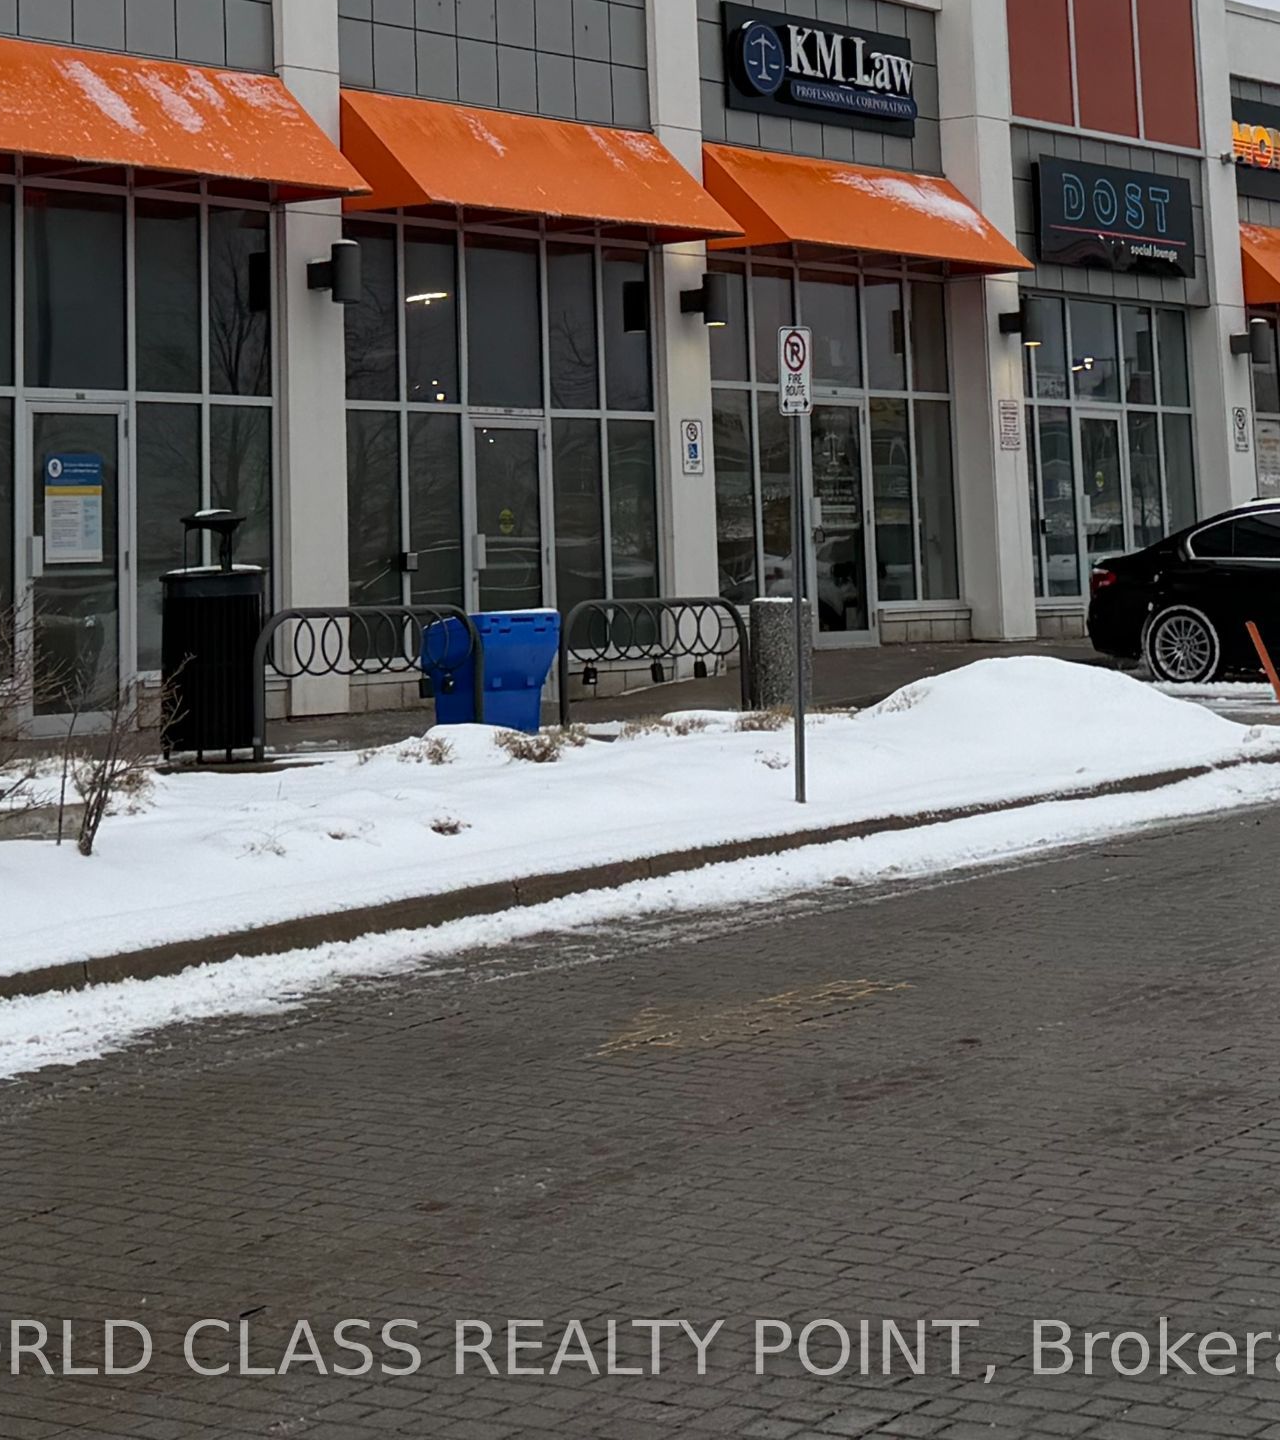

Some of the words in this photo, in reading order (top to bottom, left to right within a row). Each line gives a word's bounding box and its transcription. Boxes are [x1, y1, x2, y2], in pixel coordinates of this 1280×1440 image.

[786, 24, 846, 82] KM
[849, 36, 914, 96] Law
[1062, 172, 1170, 233] DOST
[1130, 244, 1152, 257] social
